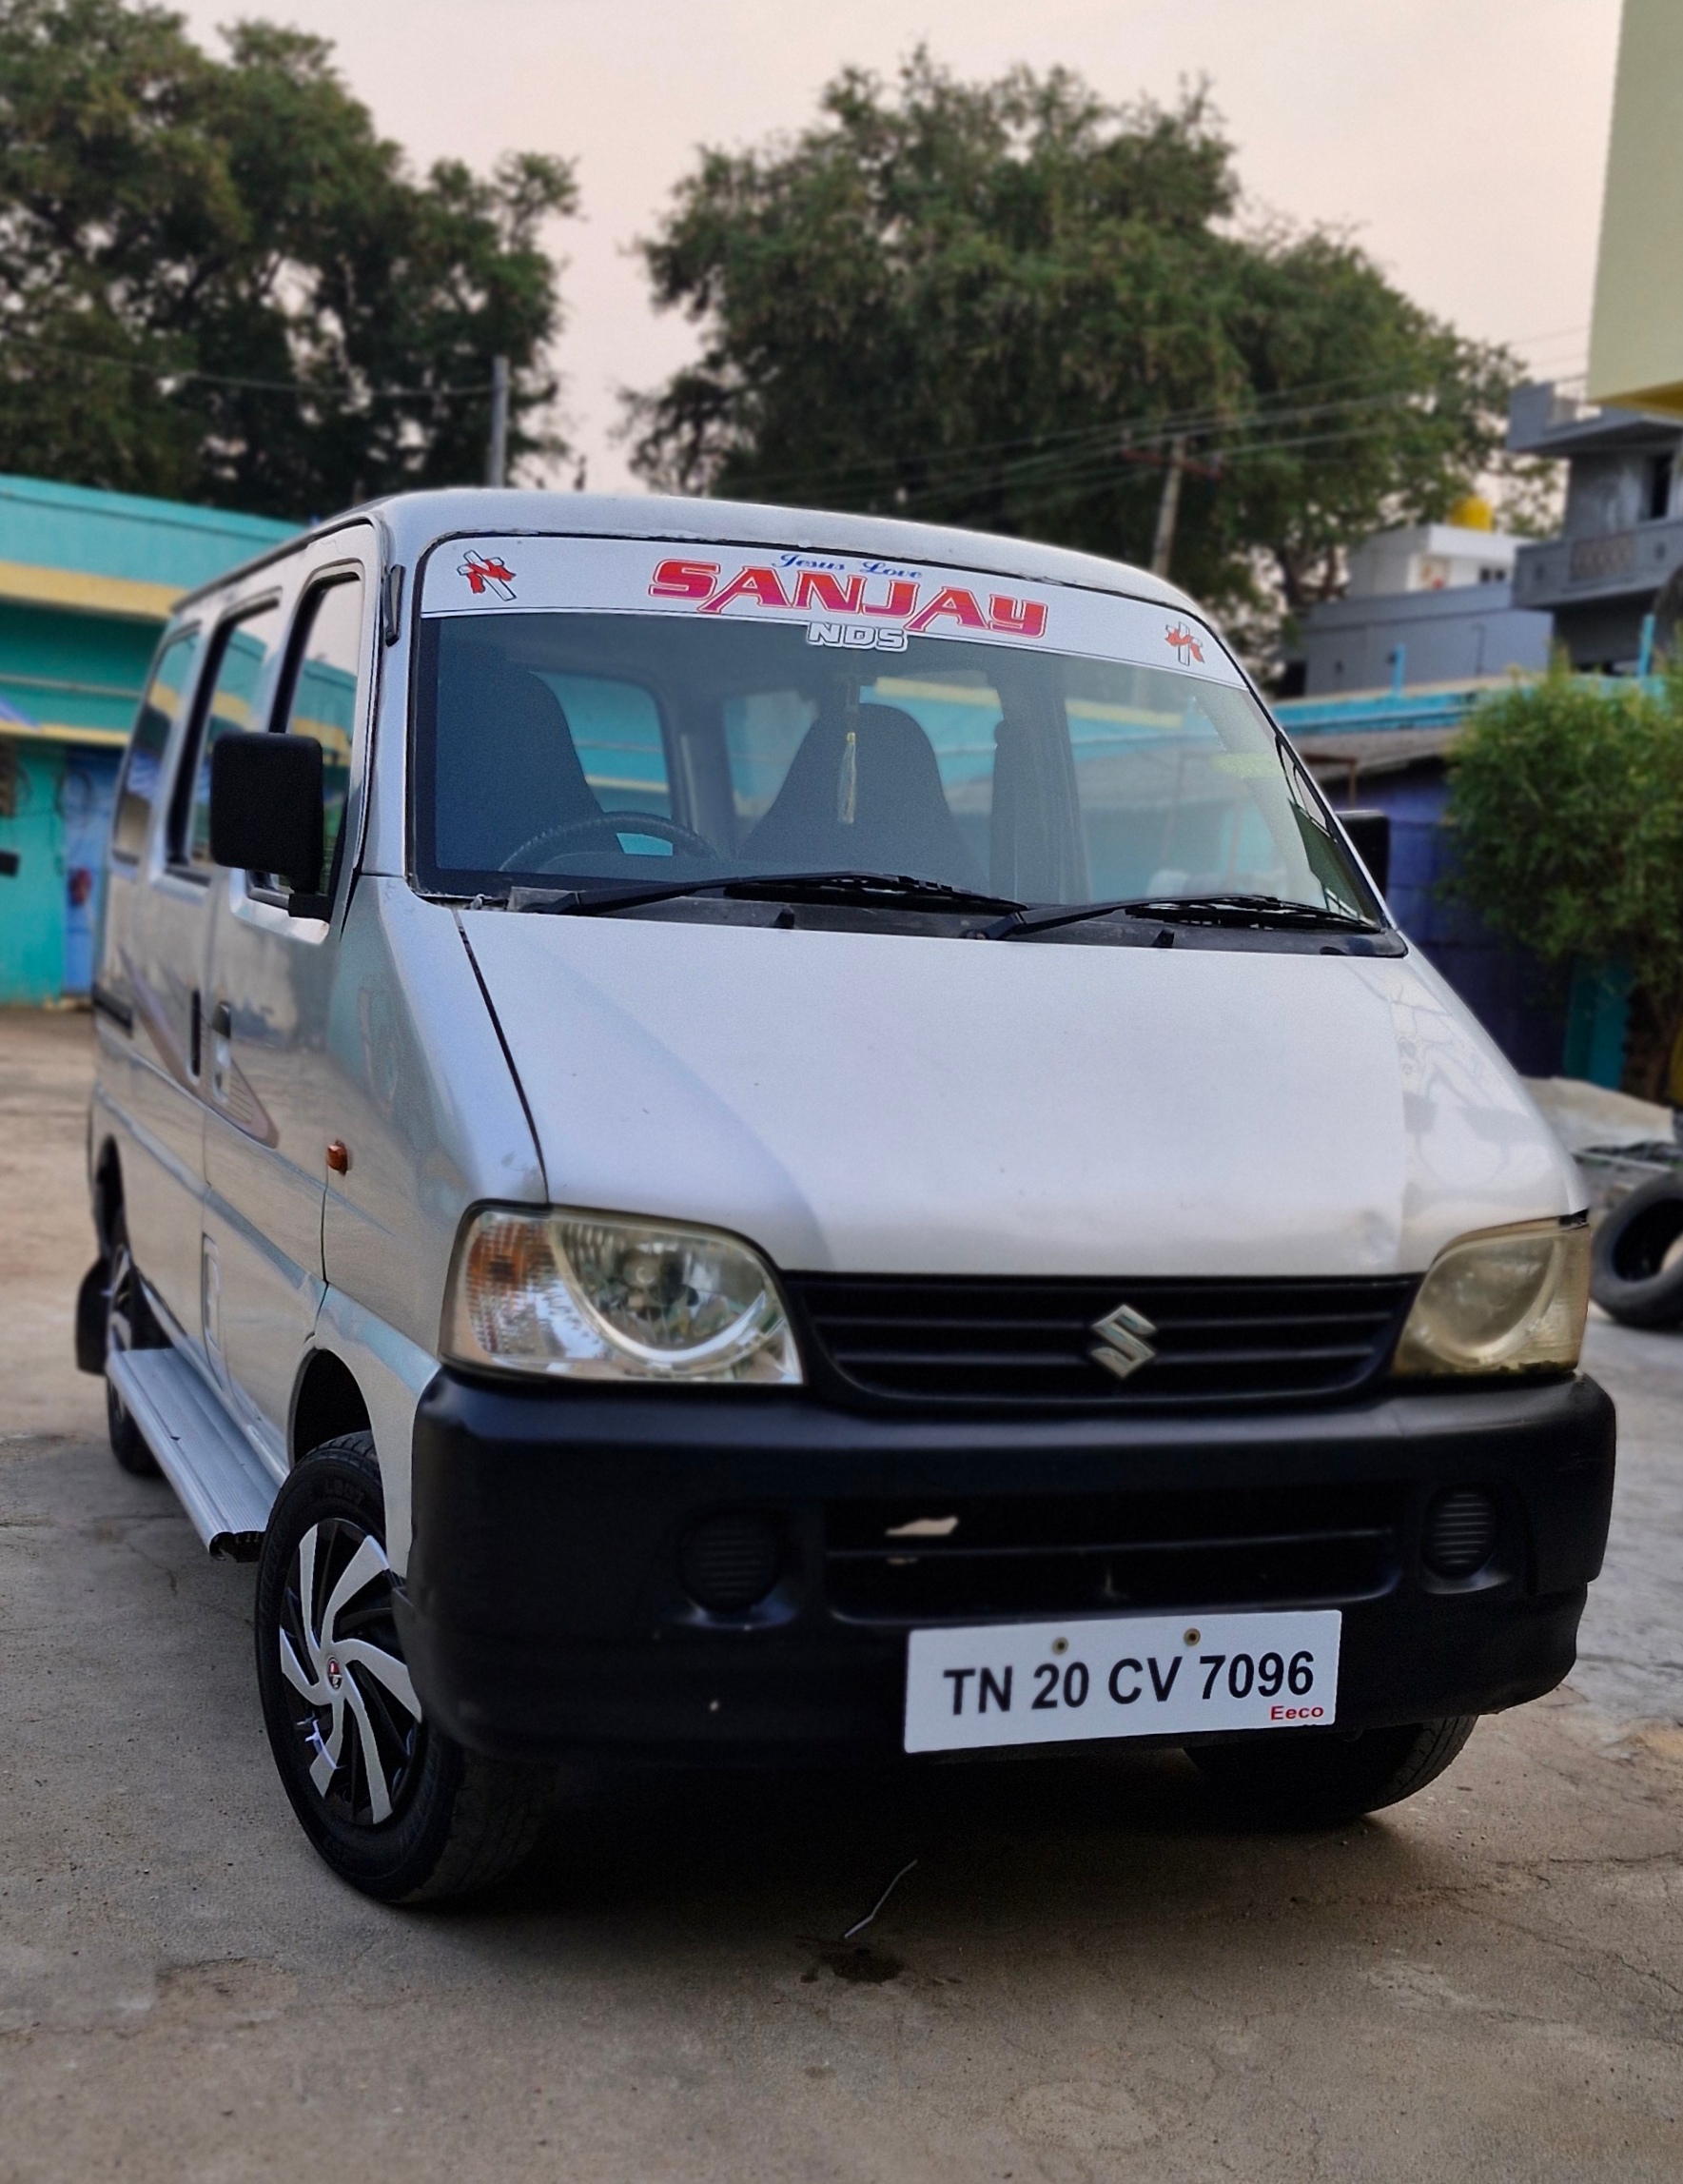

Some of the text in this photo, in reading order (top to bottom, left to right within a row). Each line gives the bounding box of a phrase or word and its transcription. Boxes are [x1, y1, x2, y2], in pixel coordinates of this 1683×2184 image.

[772, 553, 922, 579] Jesus Love
[649, 559, 1048, 638] SANJAY
[807, 621, 909, 652] NDS
[944, 1650, 1315, 1715] TN 20 CV 7096
[1270, 1704, 1324, 1721] Eeco
